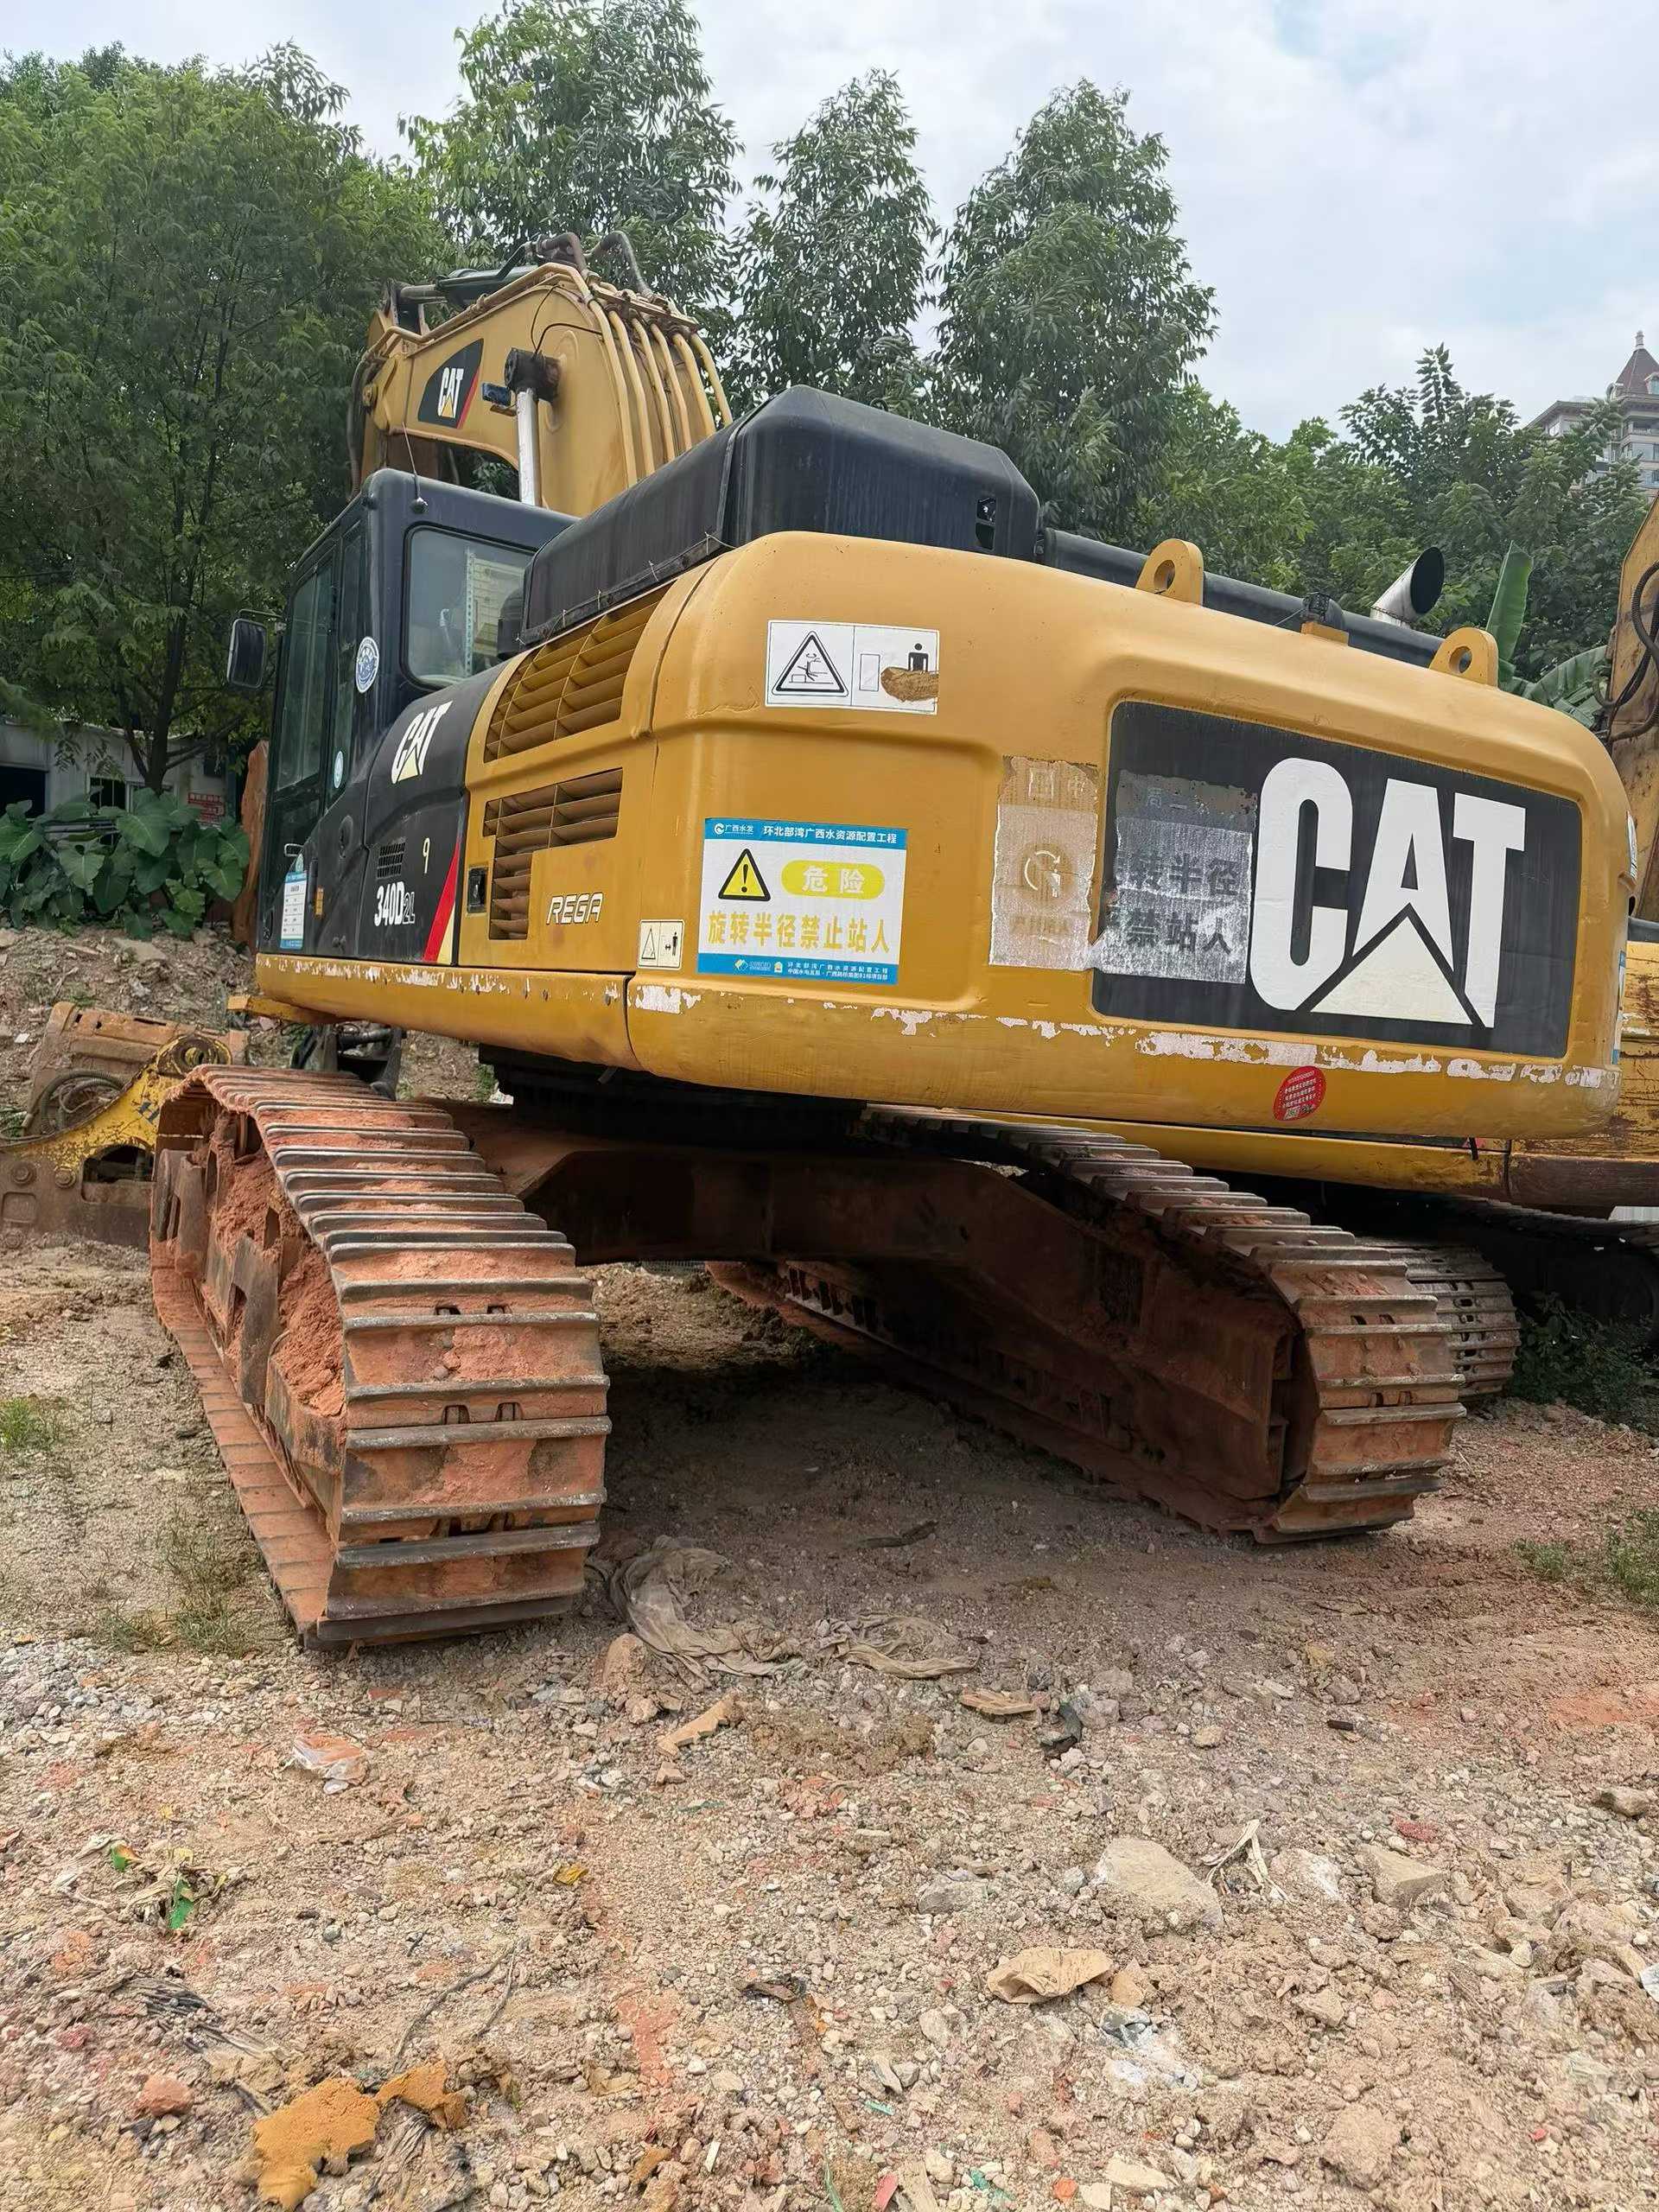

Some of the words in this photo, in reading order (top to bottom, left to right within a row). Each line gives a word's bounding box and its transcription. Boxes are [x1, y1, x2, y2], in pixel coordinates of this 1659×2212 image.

[437, 367, 464, 418] CAT
[391, 701, 453, 784] CAT
[725, 823, 753, 833] 广西水发
[763, 825, 897, 844] 环北部湾广西水资源配置工程
[423, 837, 431, 874] 9
[801, 865, 865, 894] 危险
[1249, 758, 1526, 1028] CAT
[546, 892, 604, 925] REGA
[707, 910, 890, 954] 旋转半径禁止站人
